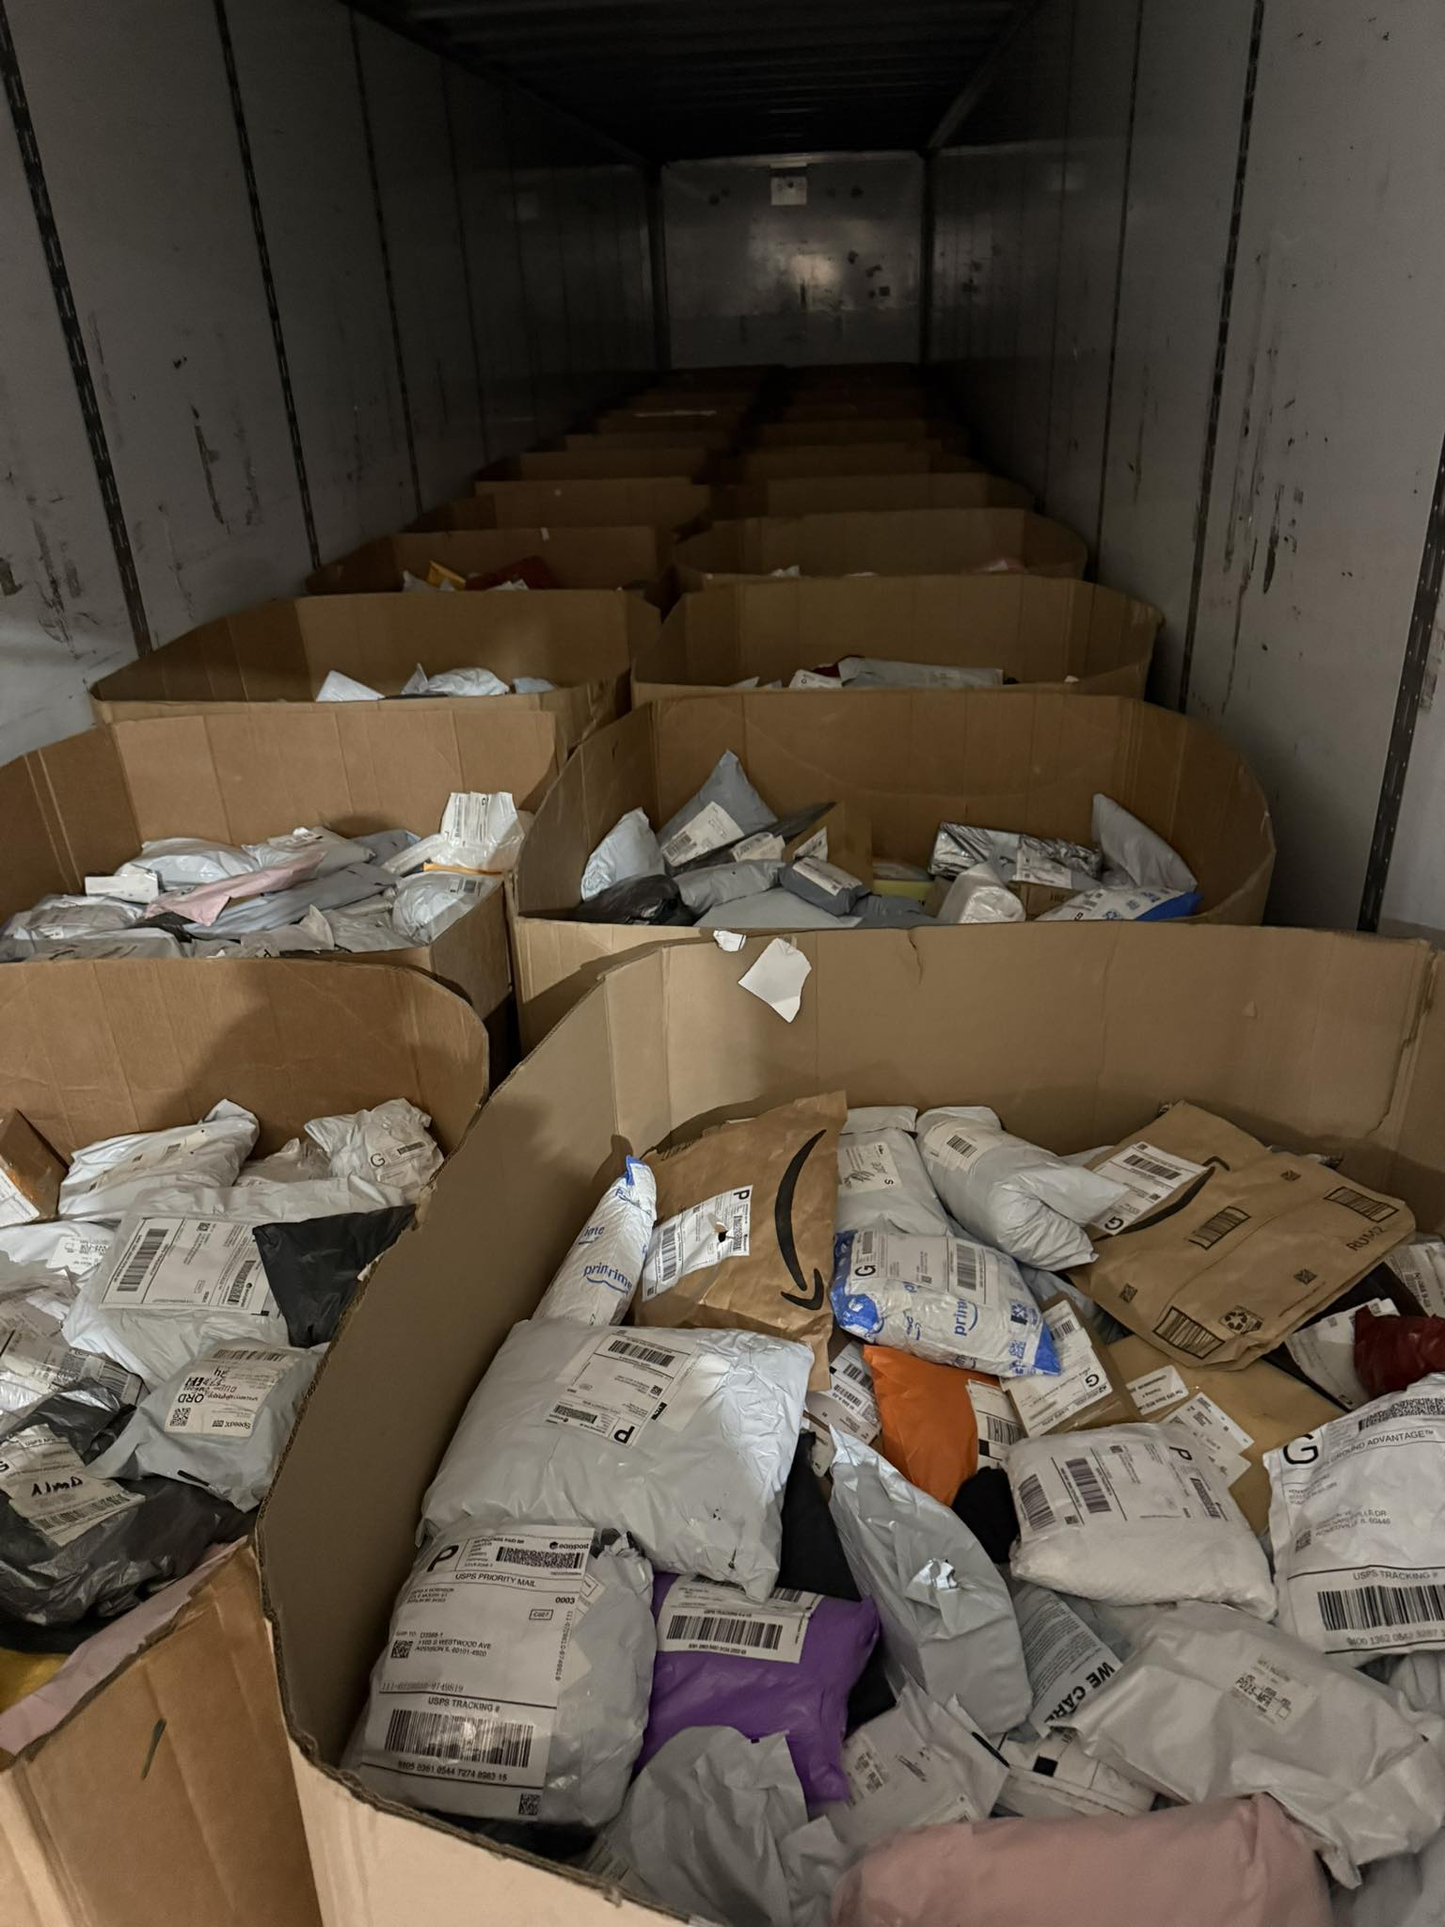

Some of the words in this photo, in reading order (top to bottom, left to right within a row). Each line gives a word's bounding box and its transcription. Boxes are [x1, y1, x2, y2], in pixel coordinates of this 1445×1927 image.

[370, 1152, 386, 1168] G
[733, 1189, 750, 1201] P
[1104, 1216, 1125, 1231] G
[855, 1265, 877, 1277] G
[1085, 1373, 1100, 1388] G
[178, 1393, 204, 1403] ORD
[613, 1425, 636, 1444] P
[1168, 1446, 1192, 1461] P
[1283, 1433, 1319, 1465] G
[426, 1545, 459, 1573] P
[455, 1572, 477, 1580] USPS
[478, 1572, 516, 1583] PRIORITY
[517, 1578, 537, 1588] MAIL
[1353, 1569, 1378, 1580] USPS
[1380, 1570, 1430, 1580] TRACKING
[555, 1596, 575, 1605] 0003
[1085, 1661, 1116, 1689] WE
[428, 1696, 450, 1707] USPS
[452, 1699, 493, 1712] TRACKING
